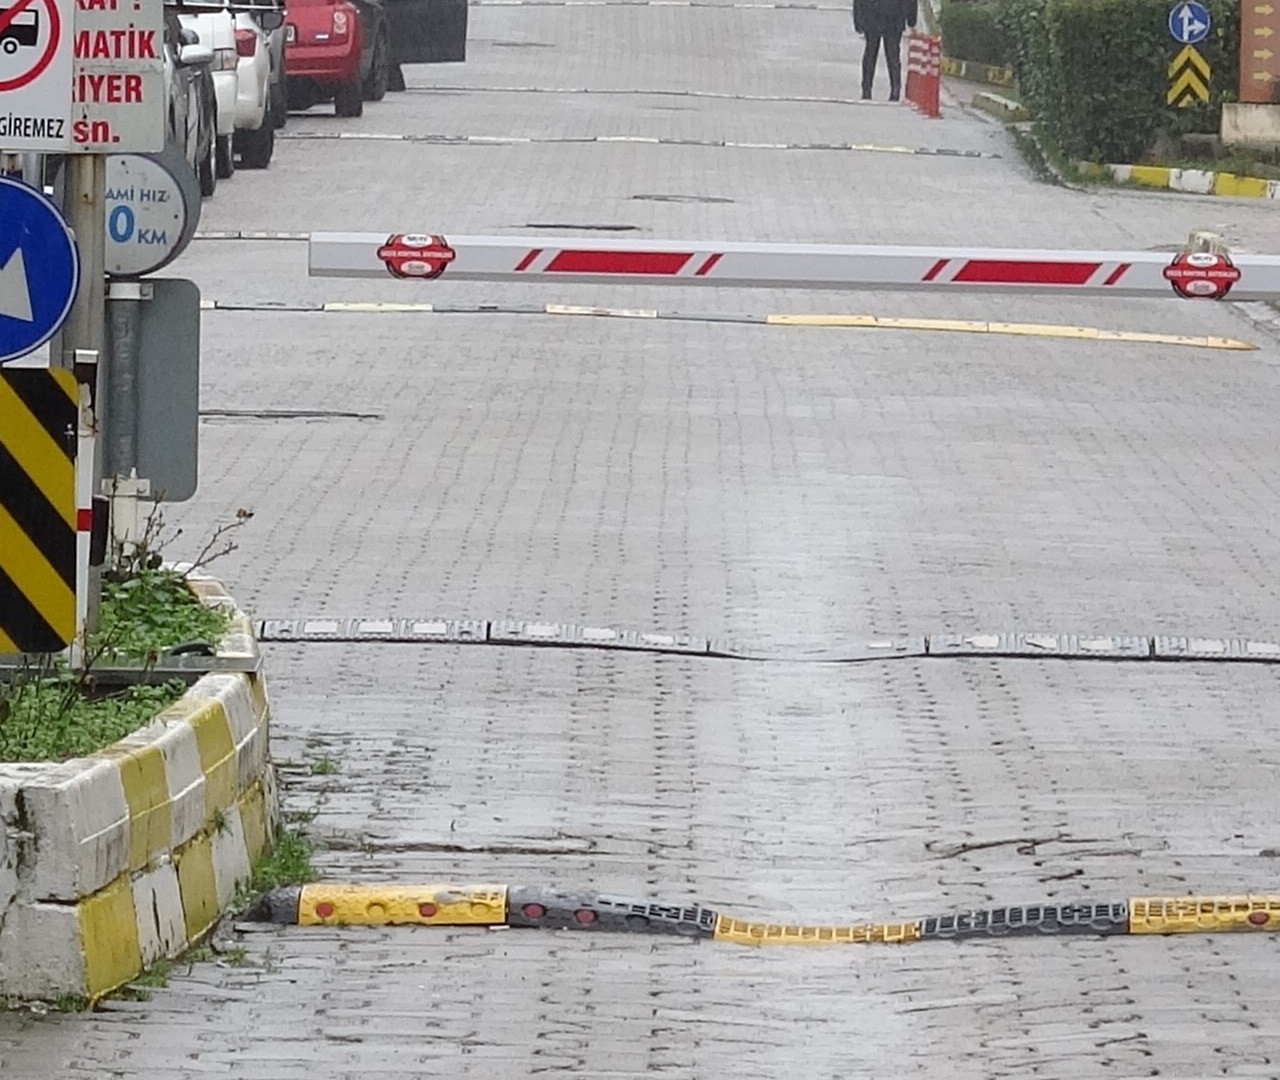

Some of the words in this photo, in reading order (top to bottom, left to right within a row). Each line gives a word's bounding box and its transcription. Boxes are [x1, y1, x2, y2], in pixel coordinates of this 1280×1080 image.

[72, 67, 143, 103] İYER
[73, 120, 120, 143] sn.
[140, 189, 167, 202] HIZ
[109, 205, 134, 243] 0
[138, 229, 167, 244] KM
